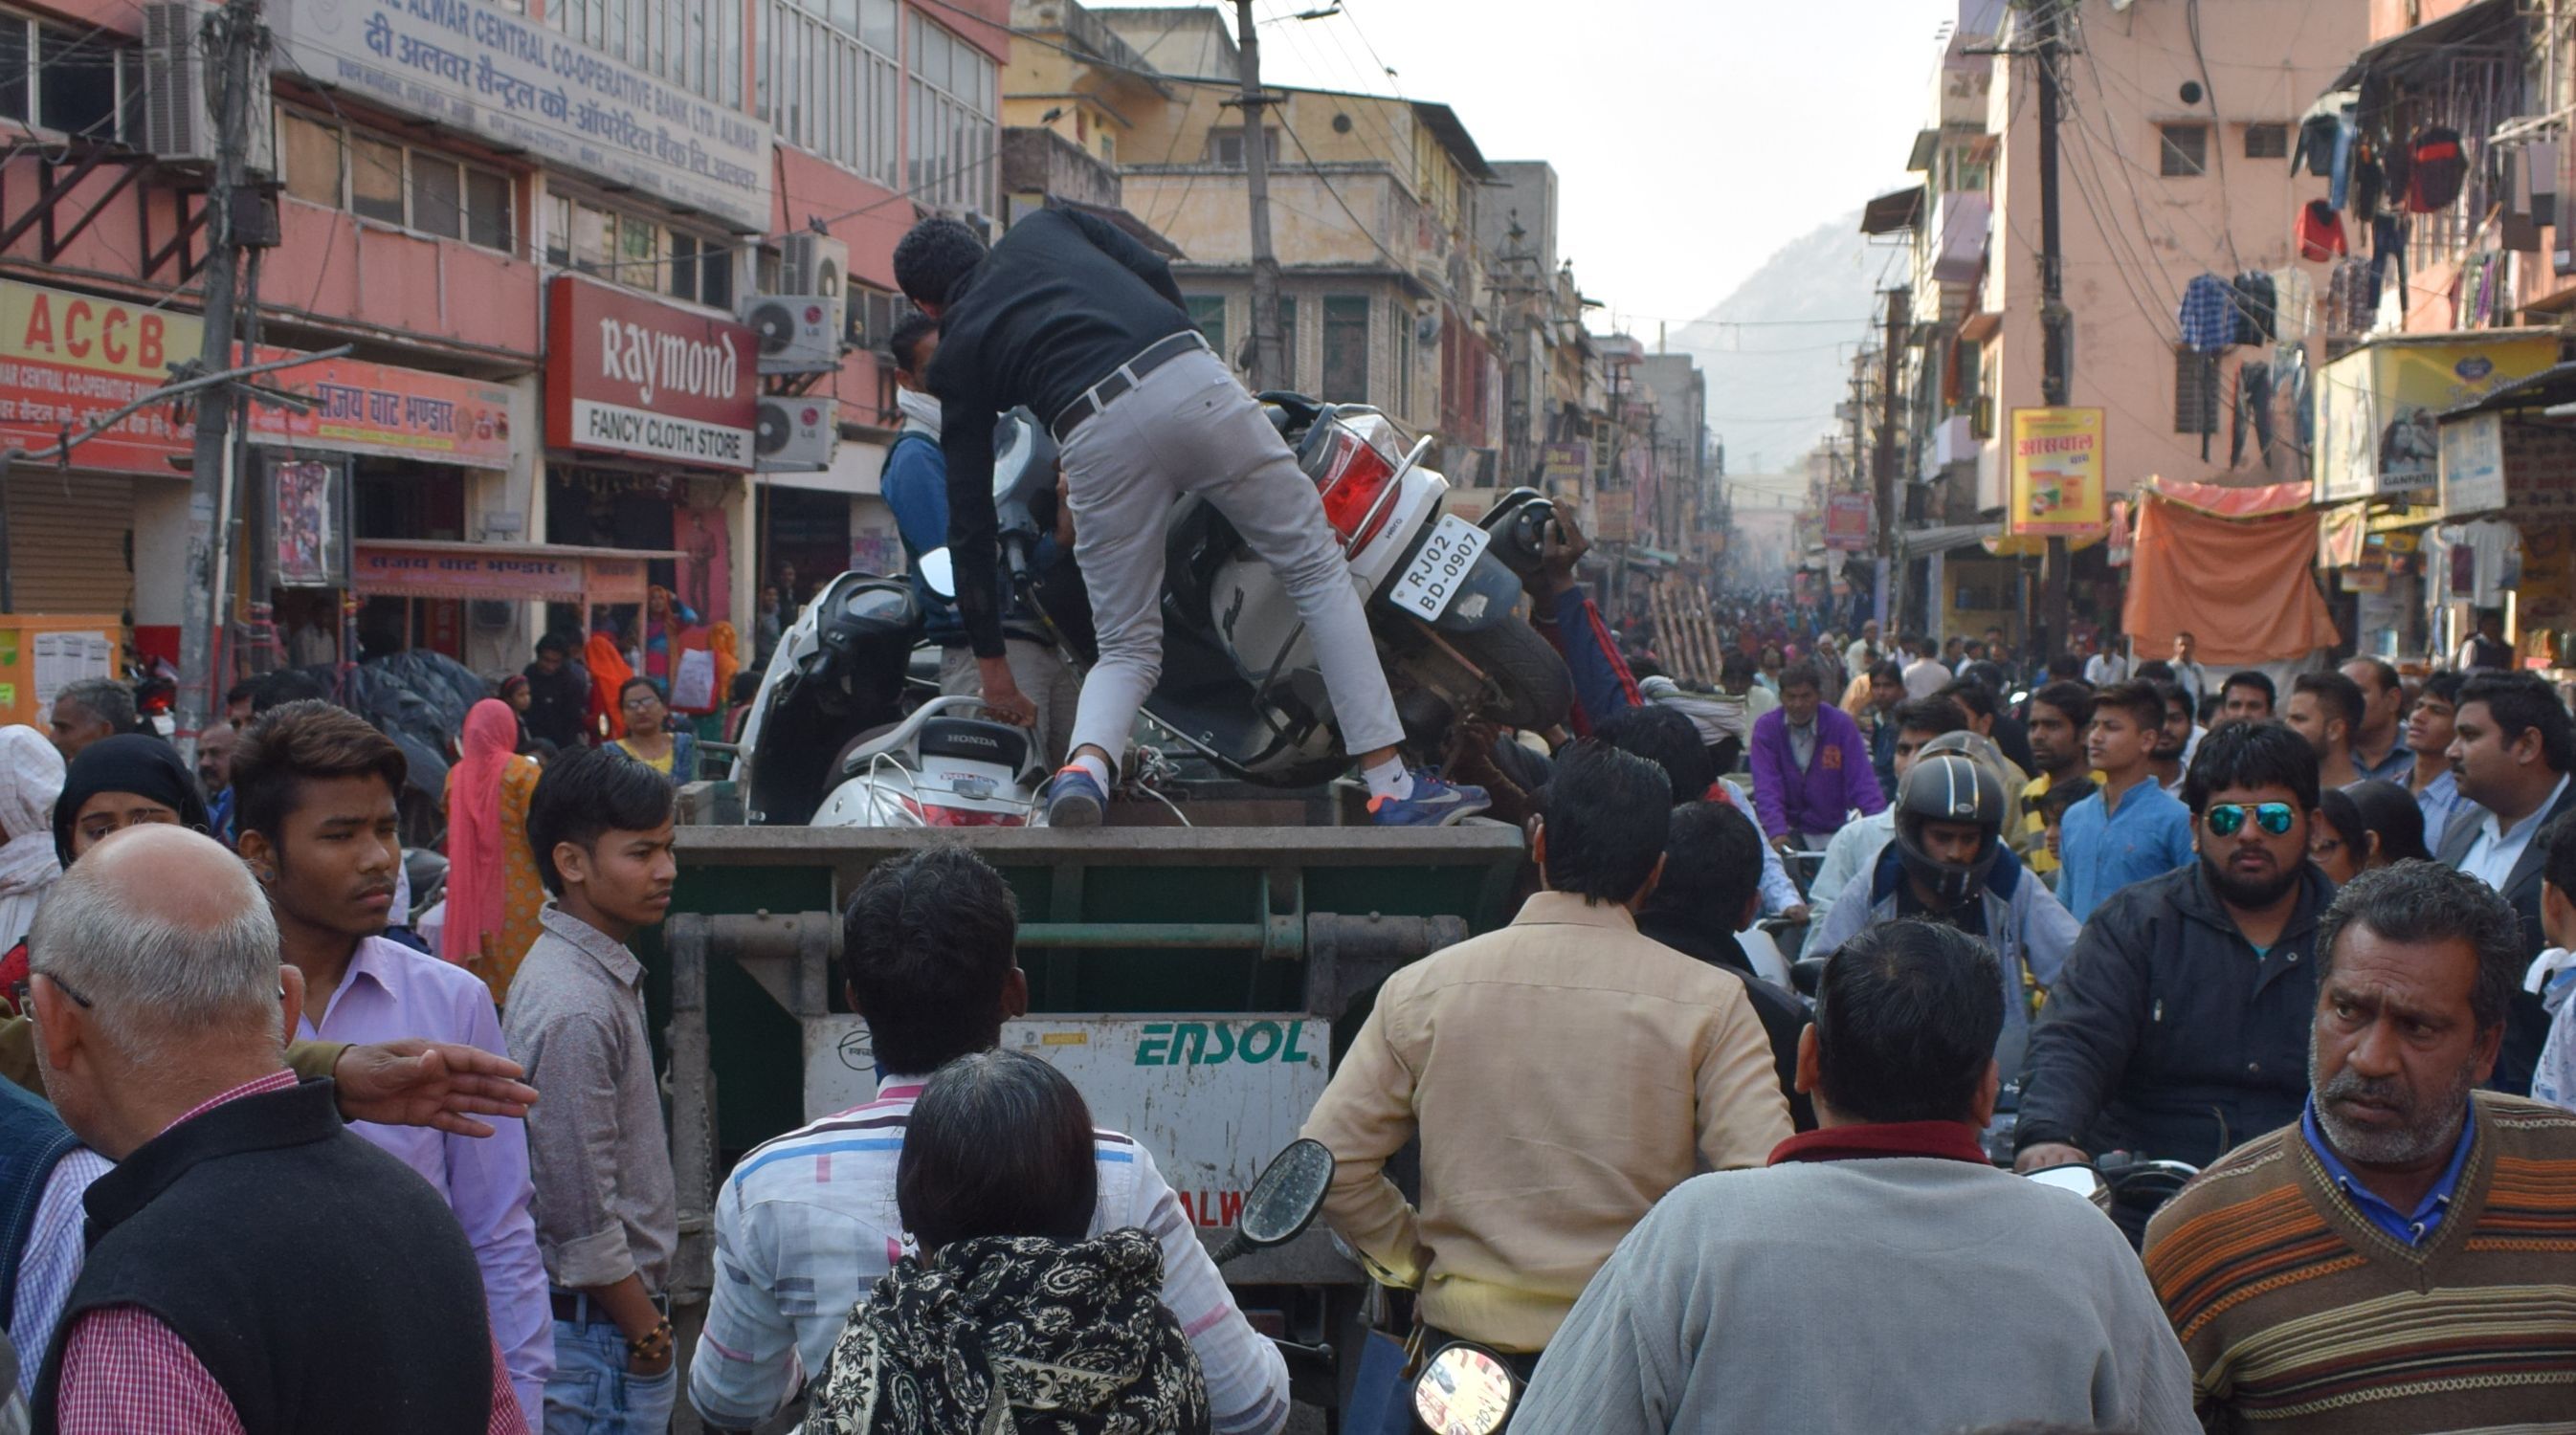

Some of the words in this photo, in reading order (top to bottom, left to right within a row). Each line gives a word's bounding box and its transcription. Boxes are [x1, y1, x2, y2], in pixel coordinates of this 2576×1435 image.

[364, 10, 393, 58] दी
[397, 33, 472, 88] अलवर
[714, 156, 759, 194] अलवर
[474, 10, 547, 70] CENTRAL
[552, 42, 652, 114] CO-OPERATIVE
[654, 87, 690, 129] BANK
[721, 116, 759, 157] ALWAR
[24, 293, 166, 369] ACCB
[599, 317, 738, 406] Raymond
[368, 389, 400, 427] चाट
[406, 394, 455, 433] भण्डार
[589, 408, 644, 444] FANCY
[646, 419, 694, 453] CLOTH
[698, 428, 741, 460] STORE
[1385, 518, 1403, 540] Hero
[1408, 535, 1452, 587] RJ02
[1418, 532, 1478, 612] BD-0907
[948, 734, 997, 748] HONDA
